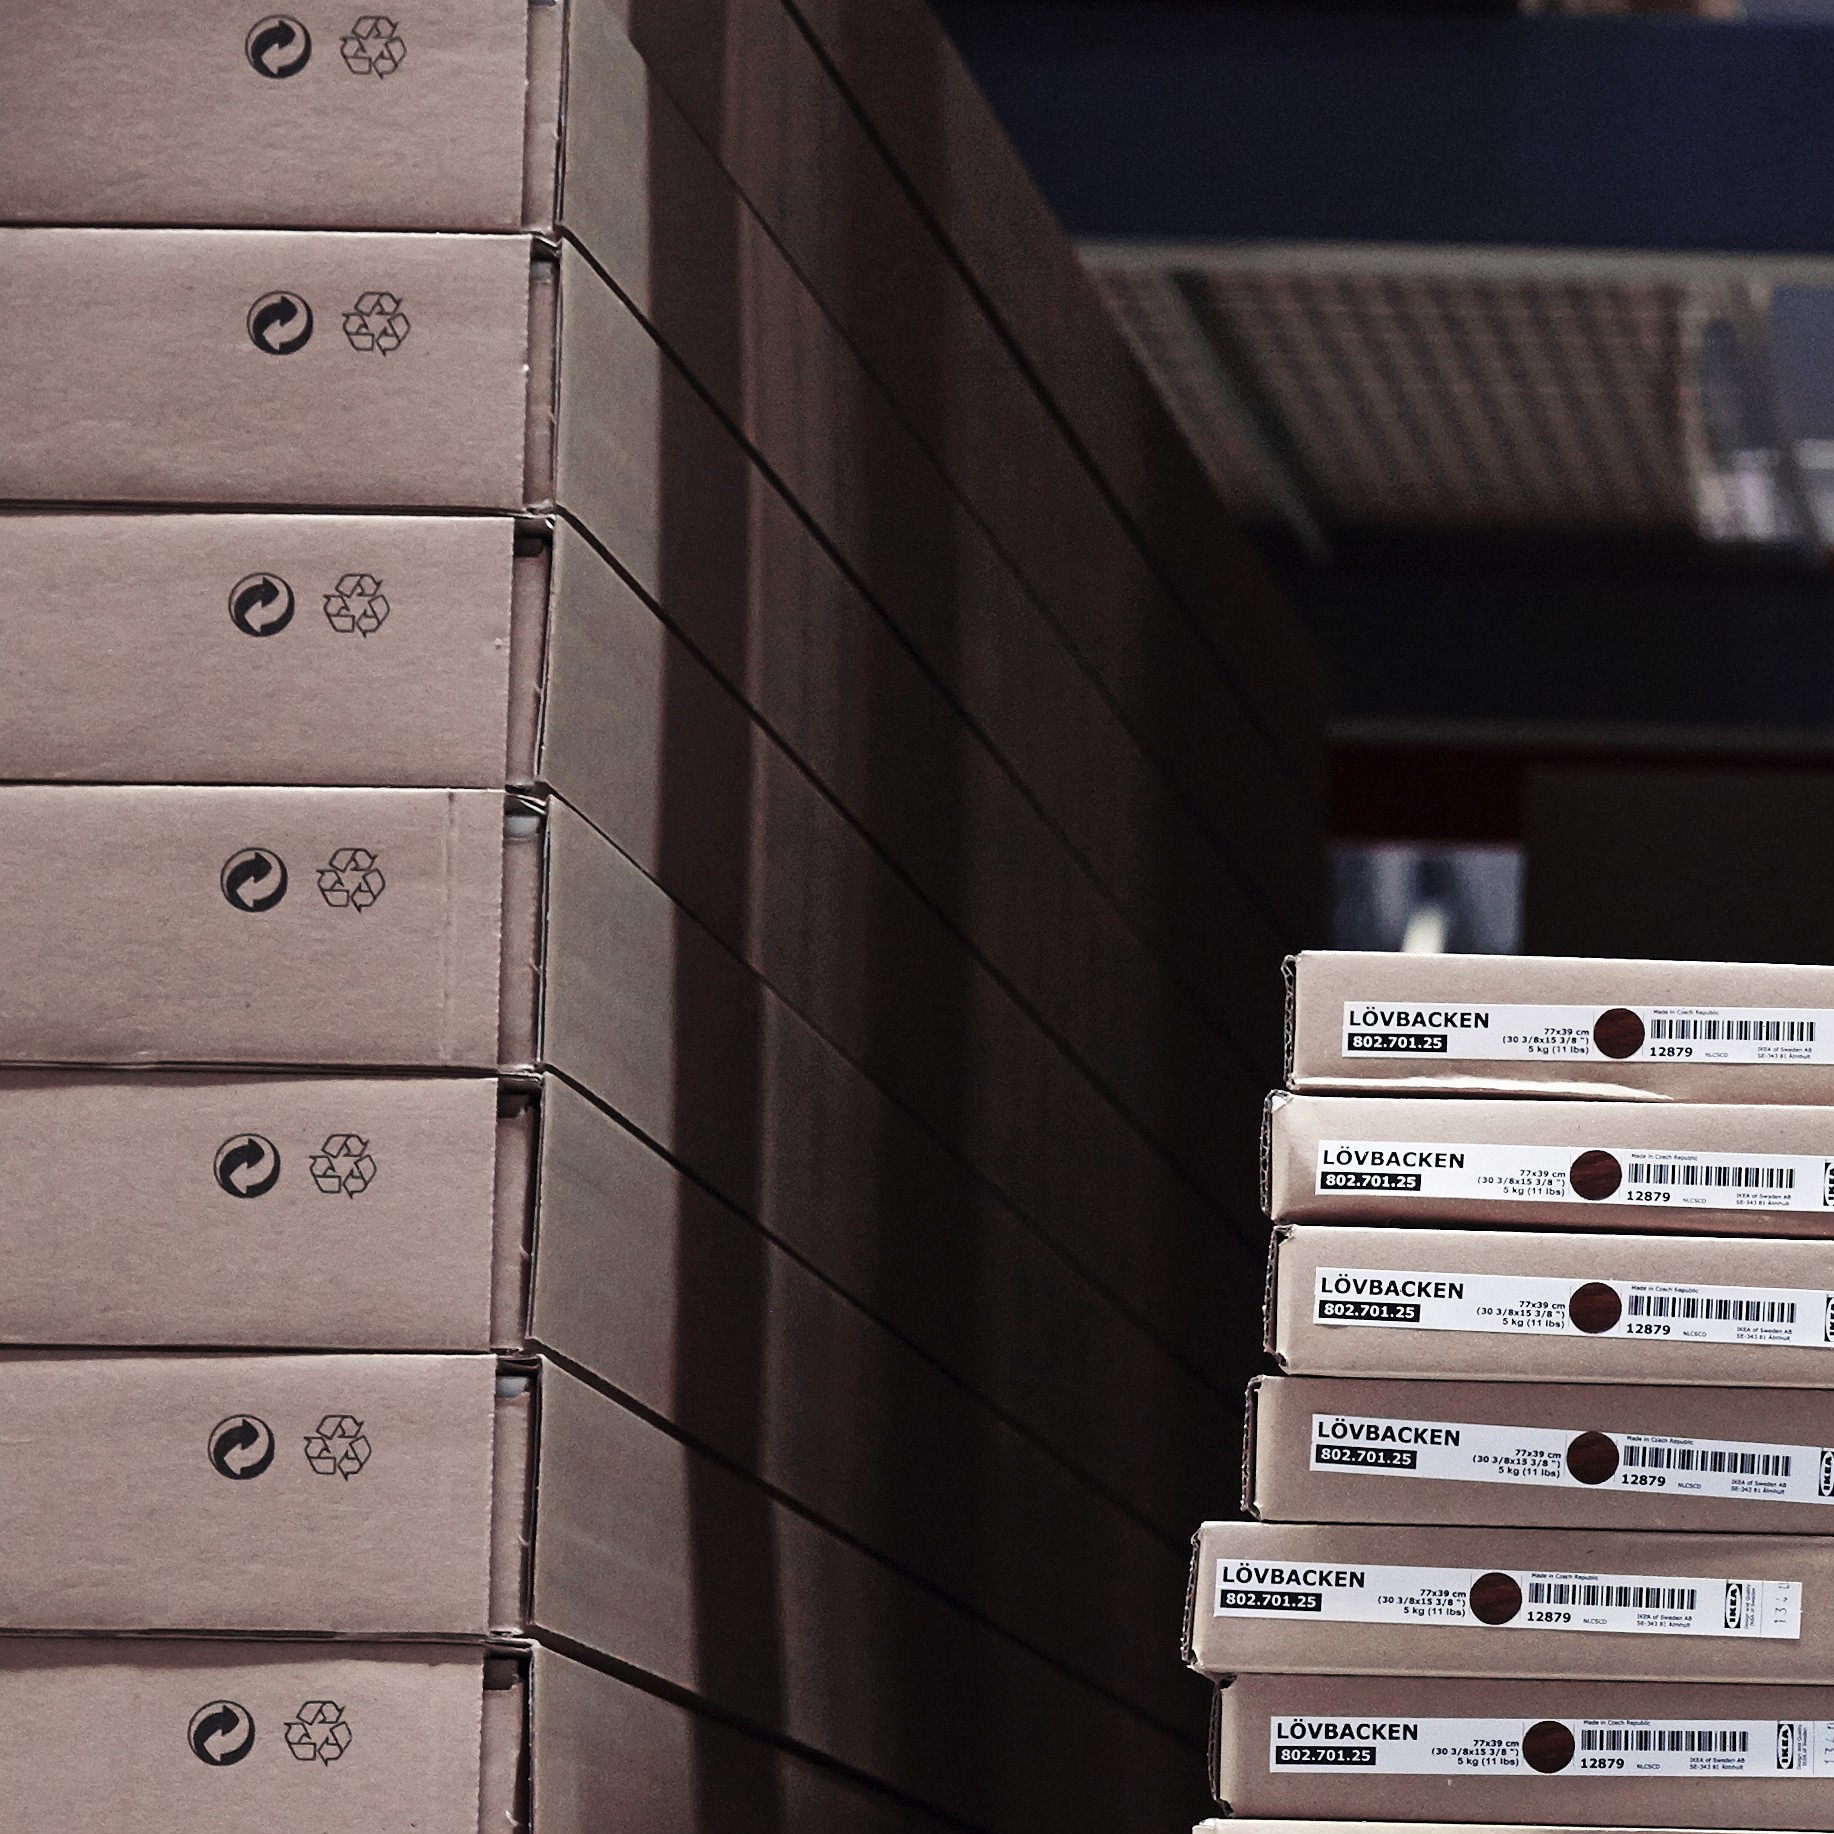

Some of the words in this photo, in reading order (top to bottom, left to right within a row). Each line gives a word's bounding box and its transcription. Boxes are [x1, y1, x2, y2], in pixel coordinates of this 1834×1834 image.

[1349, 1005, 1489, 1029] LÖVBACKEN
[1543, 1027, 1573, 1035] 77x39
[1352, 1035, 1442, 1049] 802.701.25
[1536, 1045, 1549, 1054] kg
[1649, 1046, 1693, 1057] 12879
[1322, 1145, 1465, 1169] LÖVBACKEN
[1519, 1169, 1549, 1177] 77x39
[1325, 1173, 1416, 1188] 802.701.25
[1626, 1190, 1670, 1202] 12879
[1321, 1272, 1464, 1300] LÖVBACKEN
[1323, 1302, 1415, 1319] 802.701.25
[1519, 1300, 1549, 1309] 77x39
[1510, 1317, 1524, 1328] kg
[1626, 1322, 1671, 1335] 12879
[1317, 1417, 1460, 1447] LÖVBACKEN
[1320, 1447, 1411, 1465] 802.701.25
[1515, 1448, 1545, 1458] 77x39
[1546, 1451, 1562, 1459] cm
[1621, 1473, 1666, 1487] 12879
[1222, 1562, 1365, 1588] LÖVBACKEN
[1420, 1588, 1450, 1597] 77x39
[1225, 1592, 1316, 1608] 802.701.25
[1411, 1606, 1425, 1617] kg
[1527, 1610, 1571, 1623] 12879
[1276, 1718, 1418, 1741] LÖVBACKEN
[1472, 1738, 1503, 1747] 77x39
[1280, 1748, 1371, 1761] 802.701.25
[1466, 1757, 1479, 1767] kg
[1580, 1757, 1625, 1769] 12879
